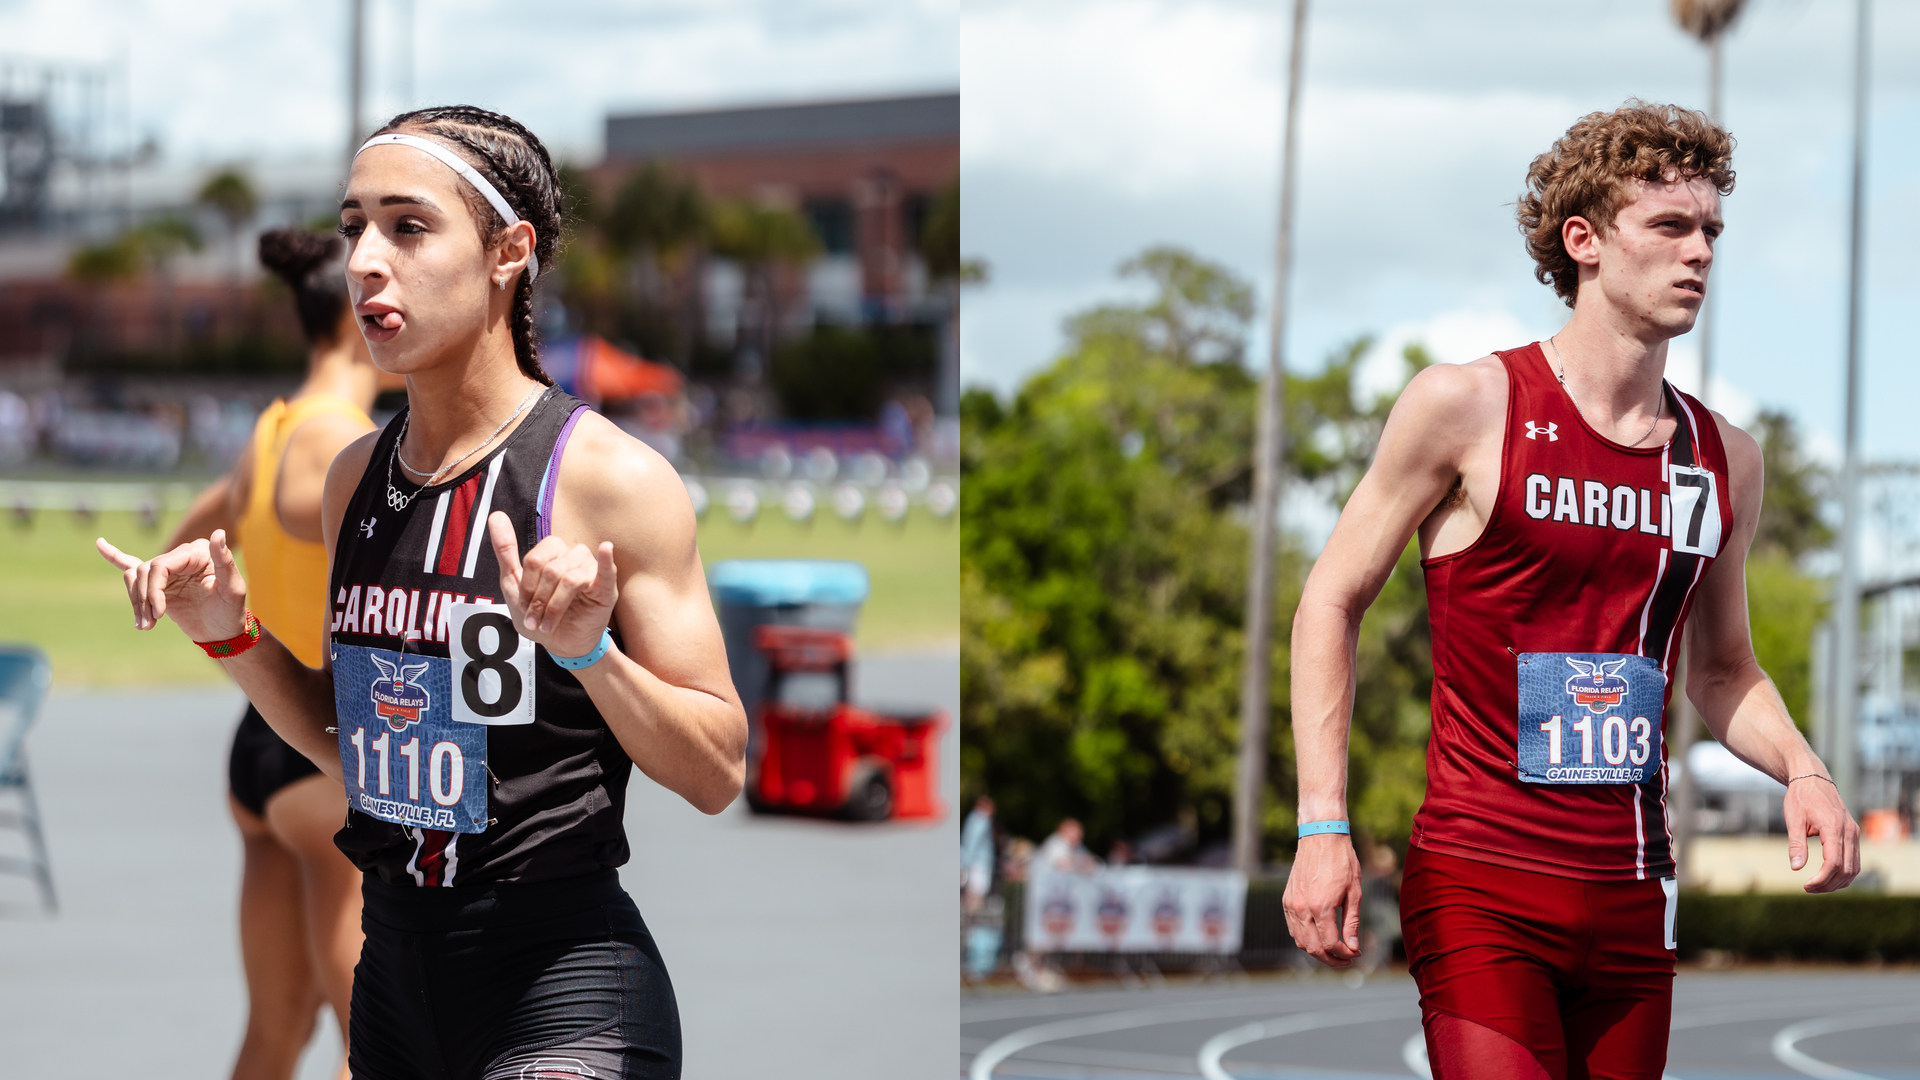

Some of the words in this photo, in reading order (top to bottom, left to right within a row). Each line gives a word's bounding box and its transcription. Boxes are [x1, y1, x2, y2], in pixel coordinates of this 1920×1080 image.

[1675, 473, 1710, 548] 7
[331, 583, 494, 644] CAROLIN
[460, 612, 523, 718] 8
[1571, 685, 1600, 694] FLORIDA
[1600, 686, 1625, 694] RELAYS
[374, 691, 398, 706] FLORIDA
[400, 698, 424, 707] RELAYS
[1540, 715, 1651, 766] 1103
[350, 726, 464, 807] 1110
[1631, 768, 1643, 781] FL
[434, 809, 456, 828] FL
